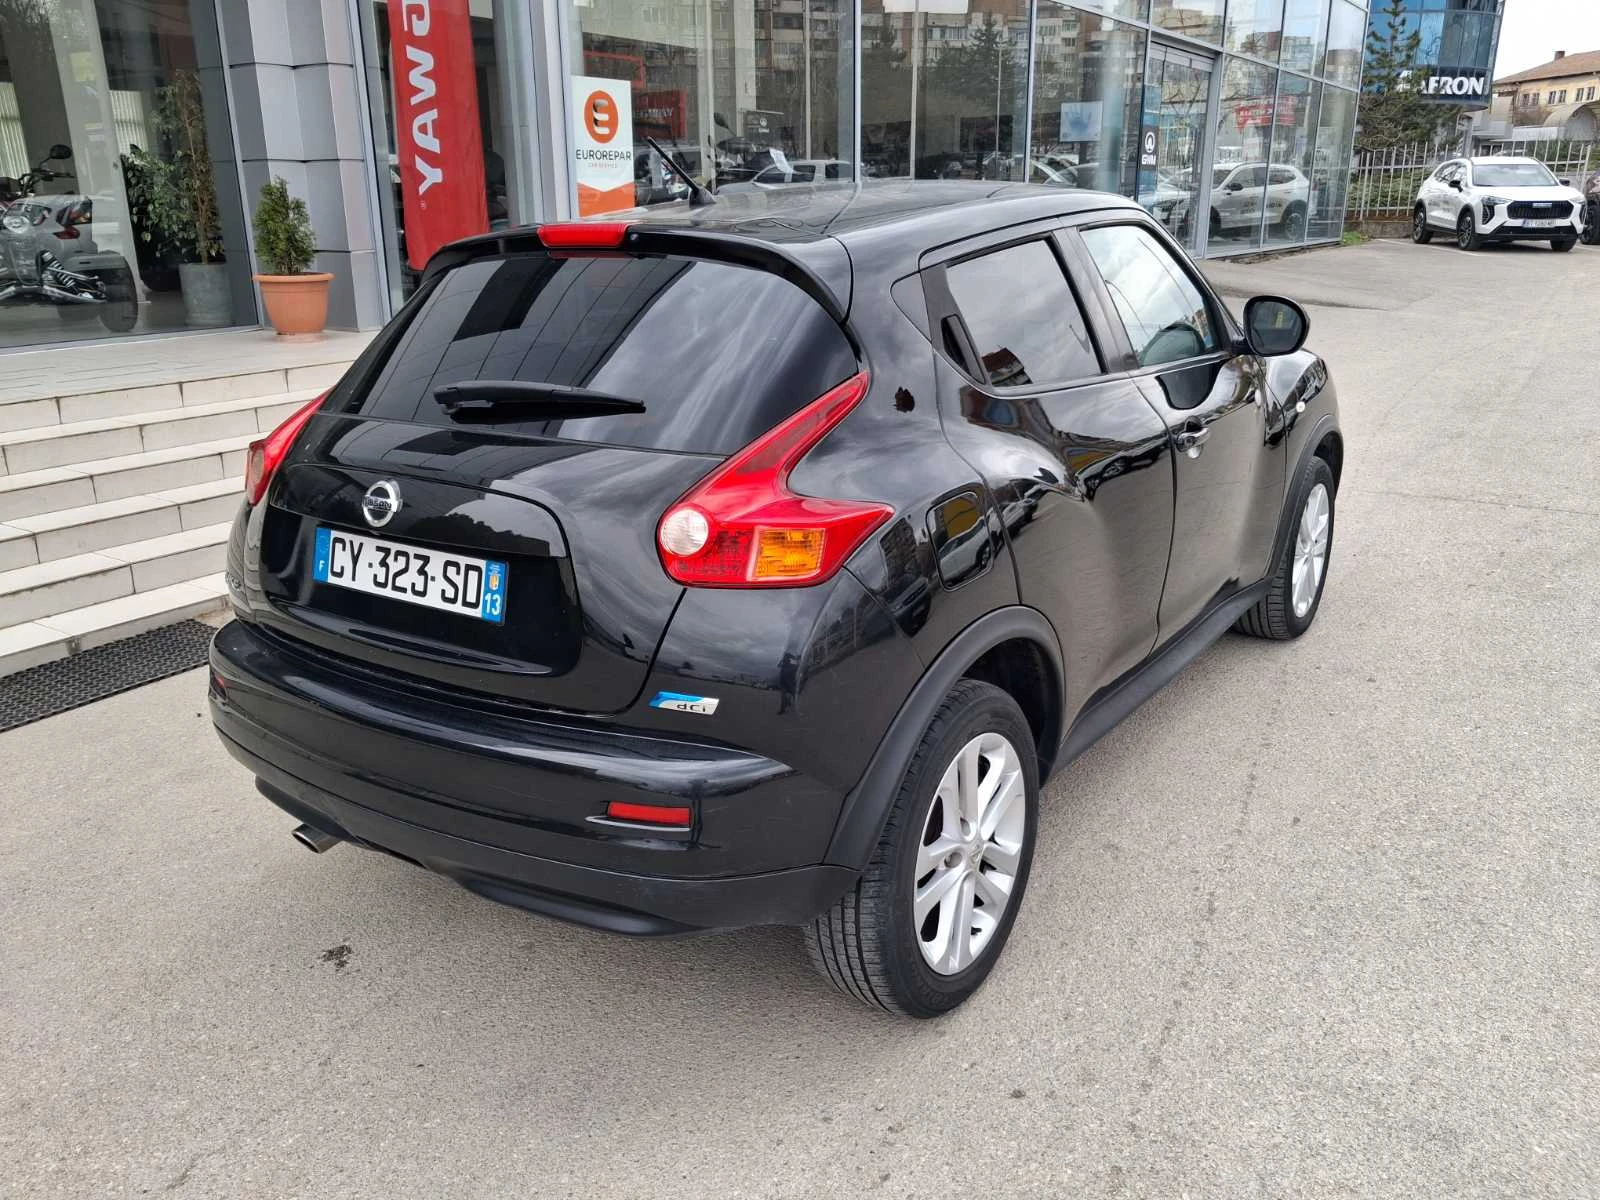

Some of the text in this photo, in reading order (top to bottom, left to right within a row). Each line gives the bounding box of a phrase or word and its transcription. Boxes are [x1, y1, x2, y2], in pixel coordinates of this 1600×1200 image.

[576, 149, 632, 161] EUROREPAR
[318, 560, 326, 573] F
[484, 592, 501, 616] 13
